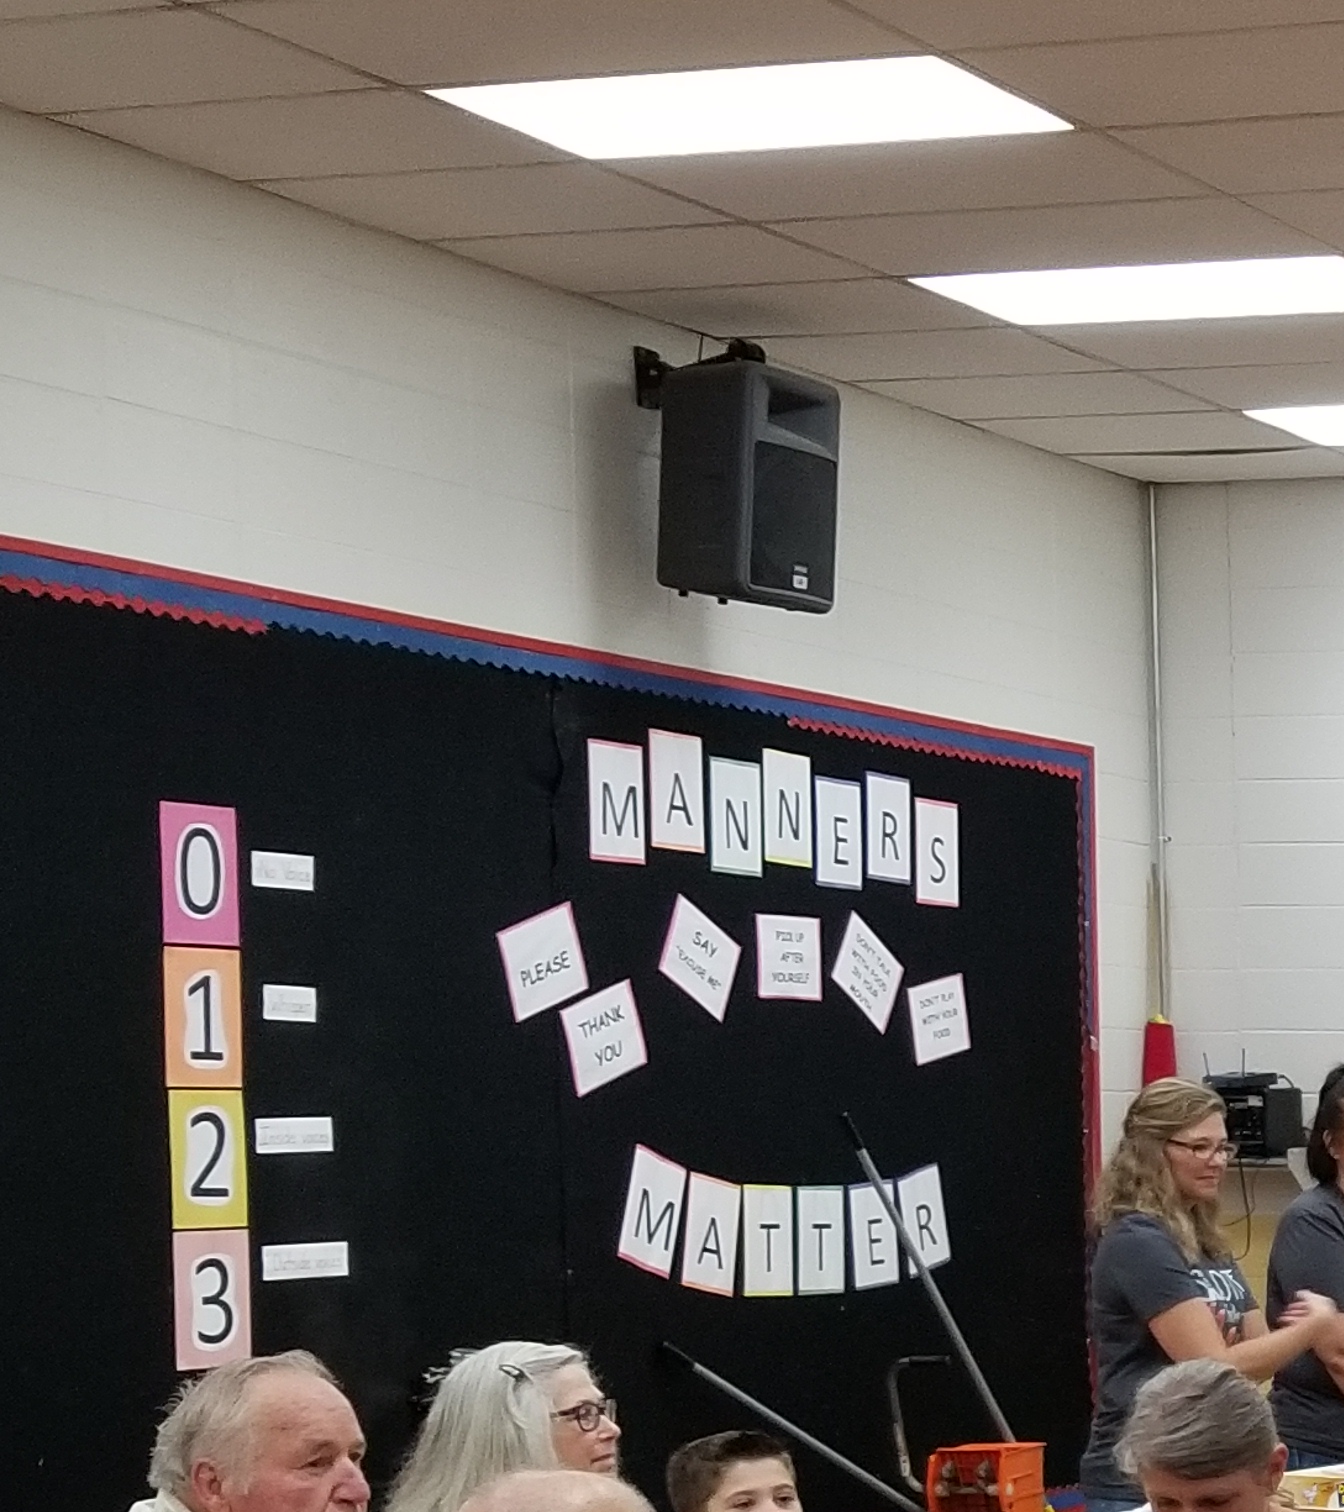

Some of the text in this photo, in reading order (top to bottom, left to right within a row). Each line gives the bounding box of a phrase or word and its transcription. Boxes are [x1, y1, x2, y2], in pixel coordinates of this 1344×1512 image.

[601, 772, 947, 885] MANNERS
[179, 827, 222, 916] 0
[520, 950, 571, 988] PLEASE
[692, 931, 718, 958] SAY
[780, 951, 804, 964] AFTER
[772, 972, 810, 985] YOURSELF
[187, 975, 225, 1060] 1
[578, 1004, 626, 1039] THANK
[594, 1040, 622, 1067] YOU
[190, 1112, 229, 1198] 2
[634, 1188, 938, 1273] MATTER
[194, 1258, 234, 1345] 3
